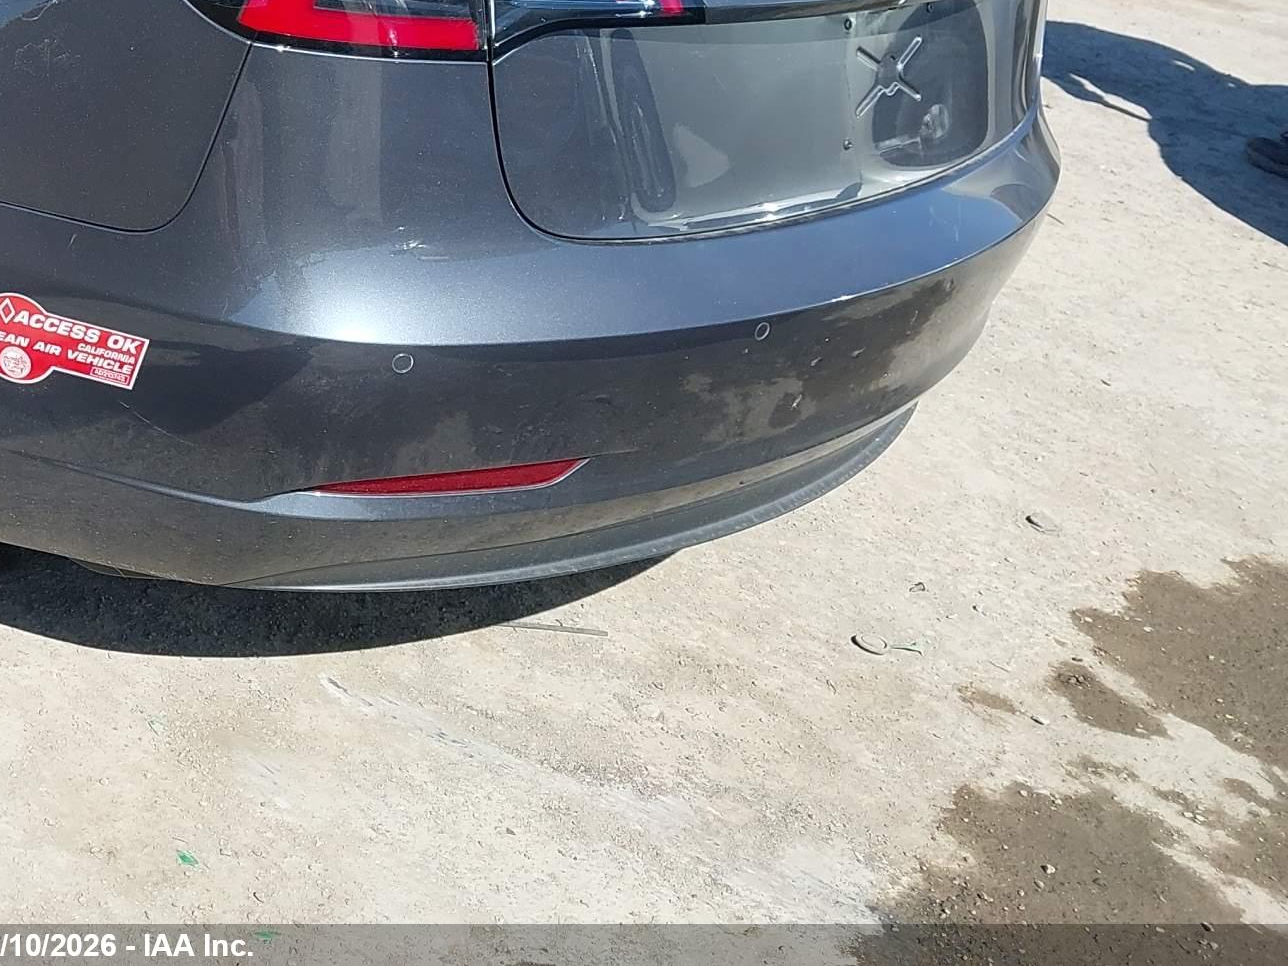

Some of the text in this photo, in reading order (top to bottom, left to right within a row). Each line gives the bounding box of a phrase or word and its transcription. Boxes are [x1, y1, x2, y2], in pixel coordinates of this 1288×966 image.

[13, 310, 142, 354] ACCESS OK
[33, 341, 62, 356] AIR
[67, 349, 134, 375] VEHICLE
[77, 342, 136, 365] CALIFORNIA
